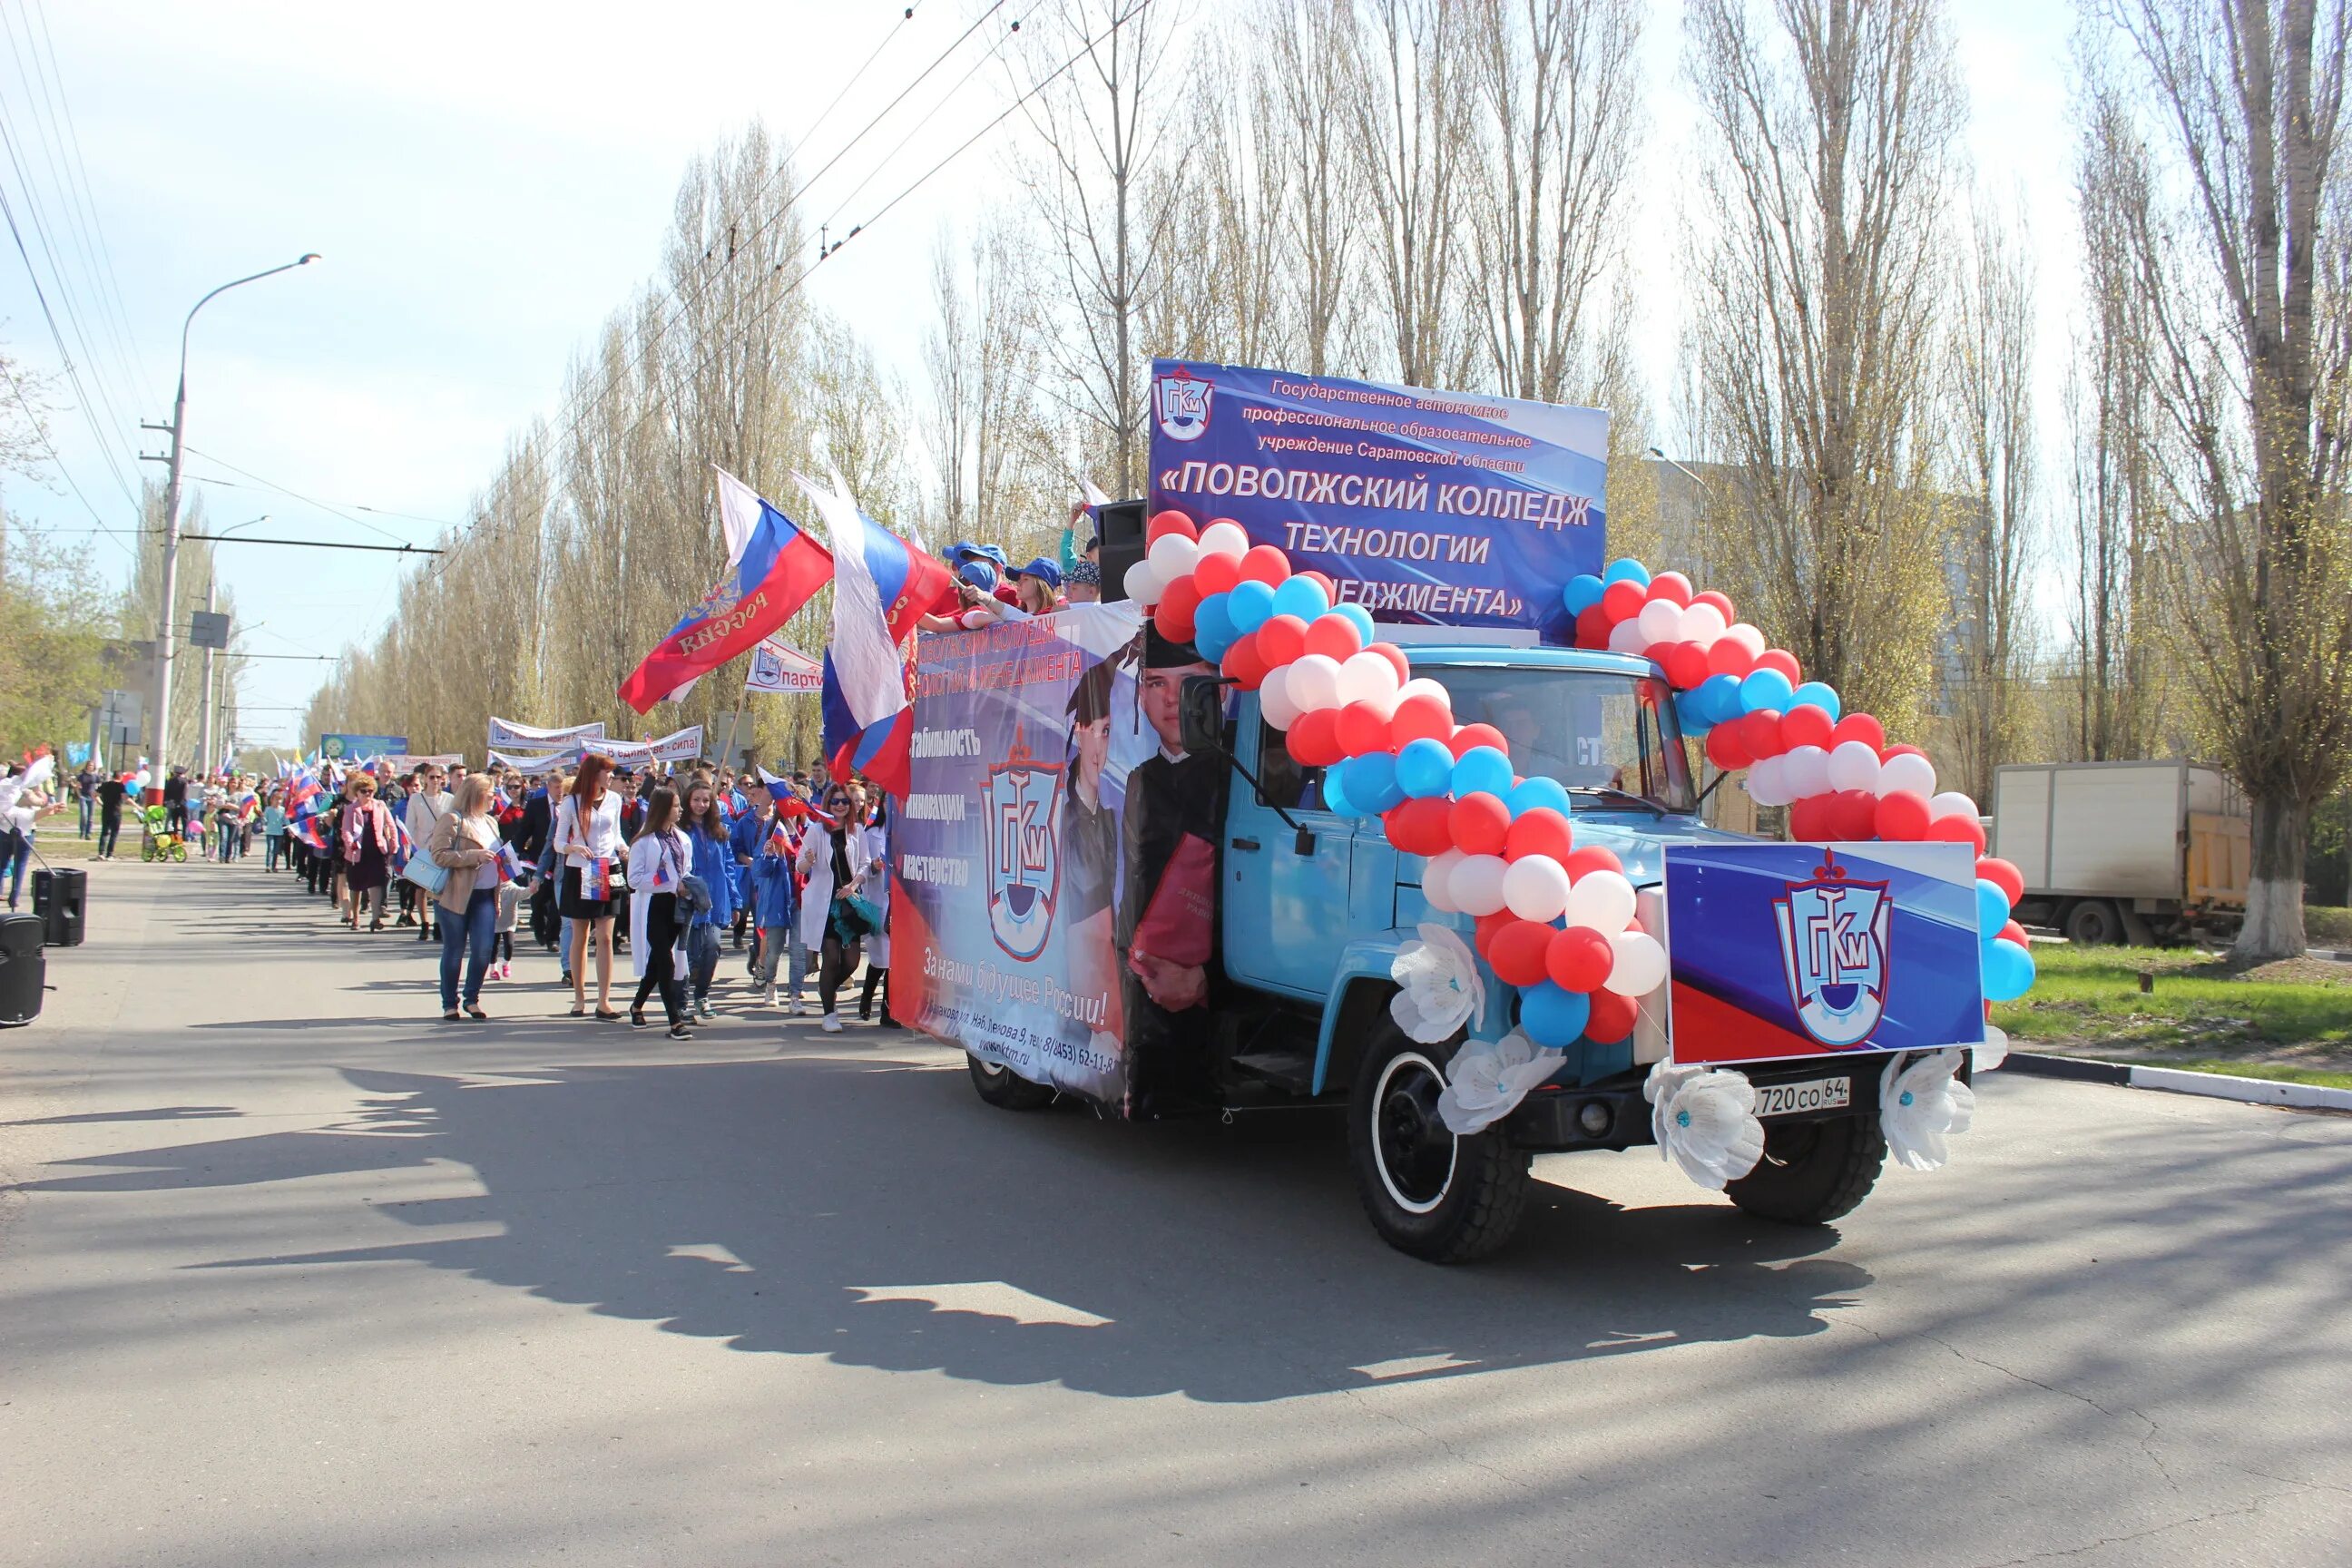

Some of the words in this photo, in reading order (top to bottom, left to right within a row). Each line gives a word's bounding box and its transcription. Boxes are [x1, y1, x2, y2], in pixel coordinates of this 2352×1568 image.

[1270, 379, 1413, 411] Государственное
[1416, 397, 1510, 422] автономное
[1242, 406, 1397, 437] профессиональное
[1399, 420, 1533, 450] образовательное
[1257, 434, 1354, 458] учреждение
[1357, 442, 1459, 467] Саратовской
[1463, 453, 1526, 475] области
[1160, 460, 1430, 513] «ПОВОЛЖСКИЙ
[1437, 484, 1593, 532] КОЛЛЕДЖ
[1284, 521, 1491, 565] ТЕХНОЛОГИИ
[917, 625, 991, 666] ОВОЛЖСКИЙ
[671, 735, 698, 750] сила!
[909, 727, 981, 759] табильность
[906, 792, 965, 826] инновации
[903, 853, 969, 887] мастерство
[977, 959, 1041, 1006] будущее
[1044, 975, 1109, 1026] России!
[1823, 1098, 1838, 1106] RUS
[1825, 1078, 1845, 1098] 64
